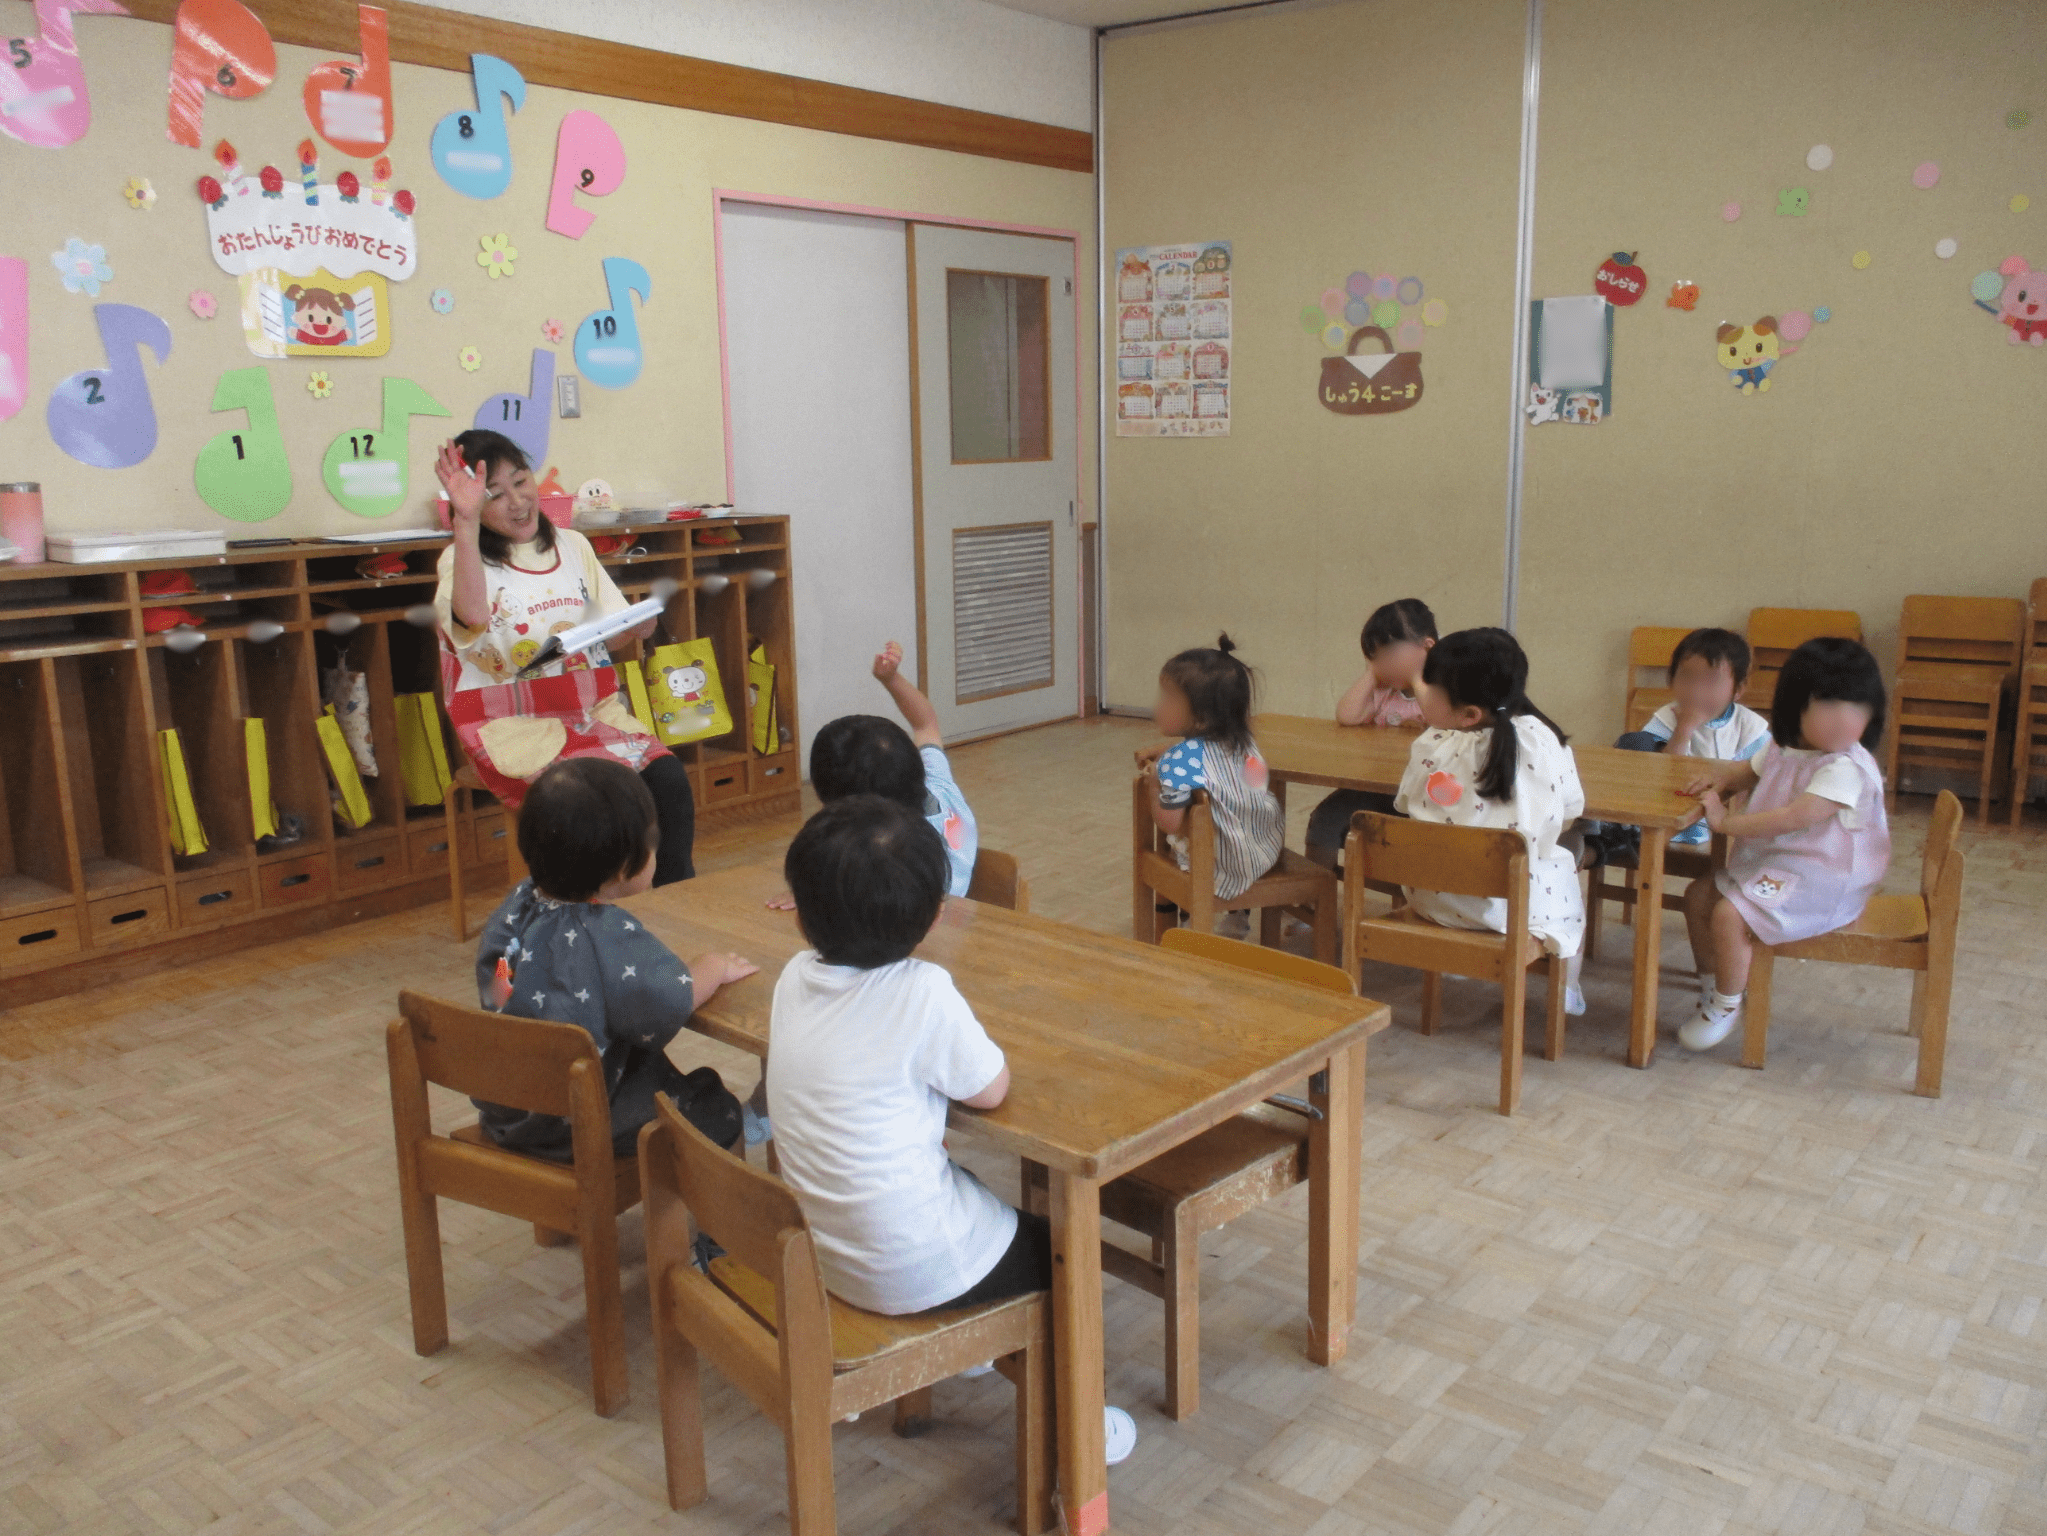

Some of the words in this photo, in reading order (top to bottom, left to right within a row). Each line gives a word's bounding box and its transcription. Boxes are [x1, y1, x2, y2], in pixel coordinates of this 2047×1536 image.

[9, 39, 33, 68] 5
[217, 64, 237, 88] 6
[340, 67, 358, 91] 7
[458, 115, 474, 139] 8
[580, 168, 595, 188] 9
[218, 222, 407, 266] おたんじょうびおめでとう
[1159, 251, 1197, 260] CALENDAR
[1596, 269, 1640, 293] おしらせ
[592, 315, 617, 340] 10
[83, 377, 105, 405] 2
[503, 399, 521, 421] 11
[232, 434, 245, 460] 1
[350, 434, 375, 458] 12
